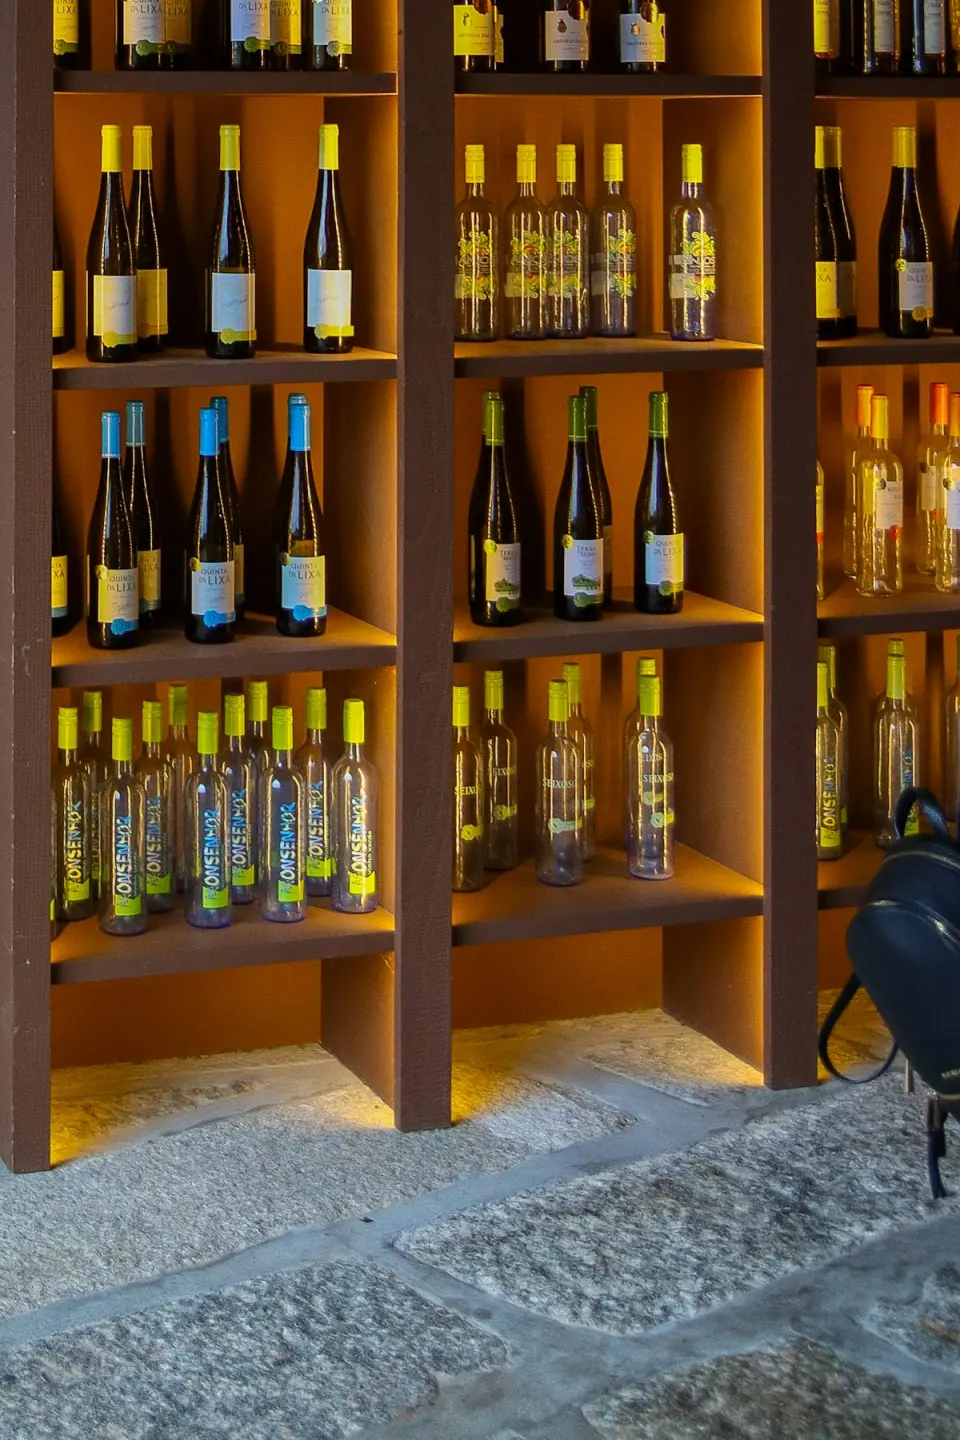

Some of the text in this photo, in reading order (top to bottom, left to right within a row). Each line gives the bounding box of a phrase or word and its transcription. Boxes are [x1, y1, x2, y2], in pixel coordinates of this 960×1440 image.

[56, 5, 78, 15] LIXA
[140, 4, 163, 14] LIXA
[248, 1, 269, 11] LIXA
[331, 6, 351, 15] LIXA
[277, 7, 299, 17] LIXA
[201, 567, 228, 575] QUINTA
[297, 569, 322, 580] LIXA
[208, 574, 232, 585] LIXA
